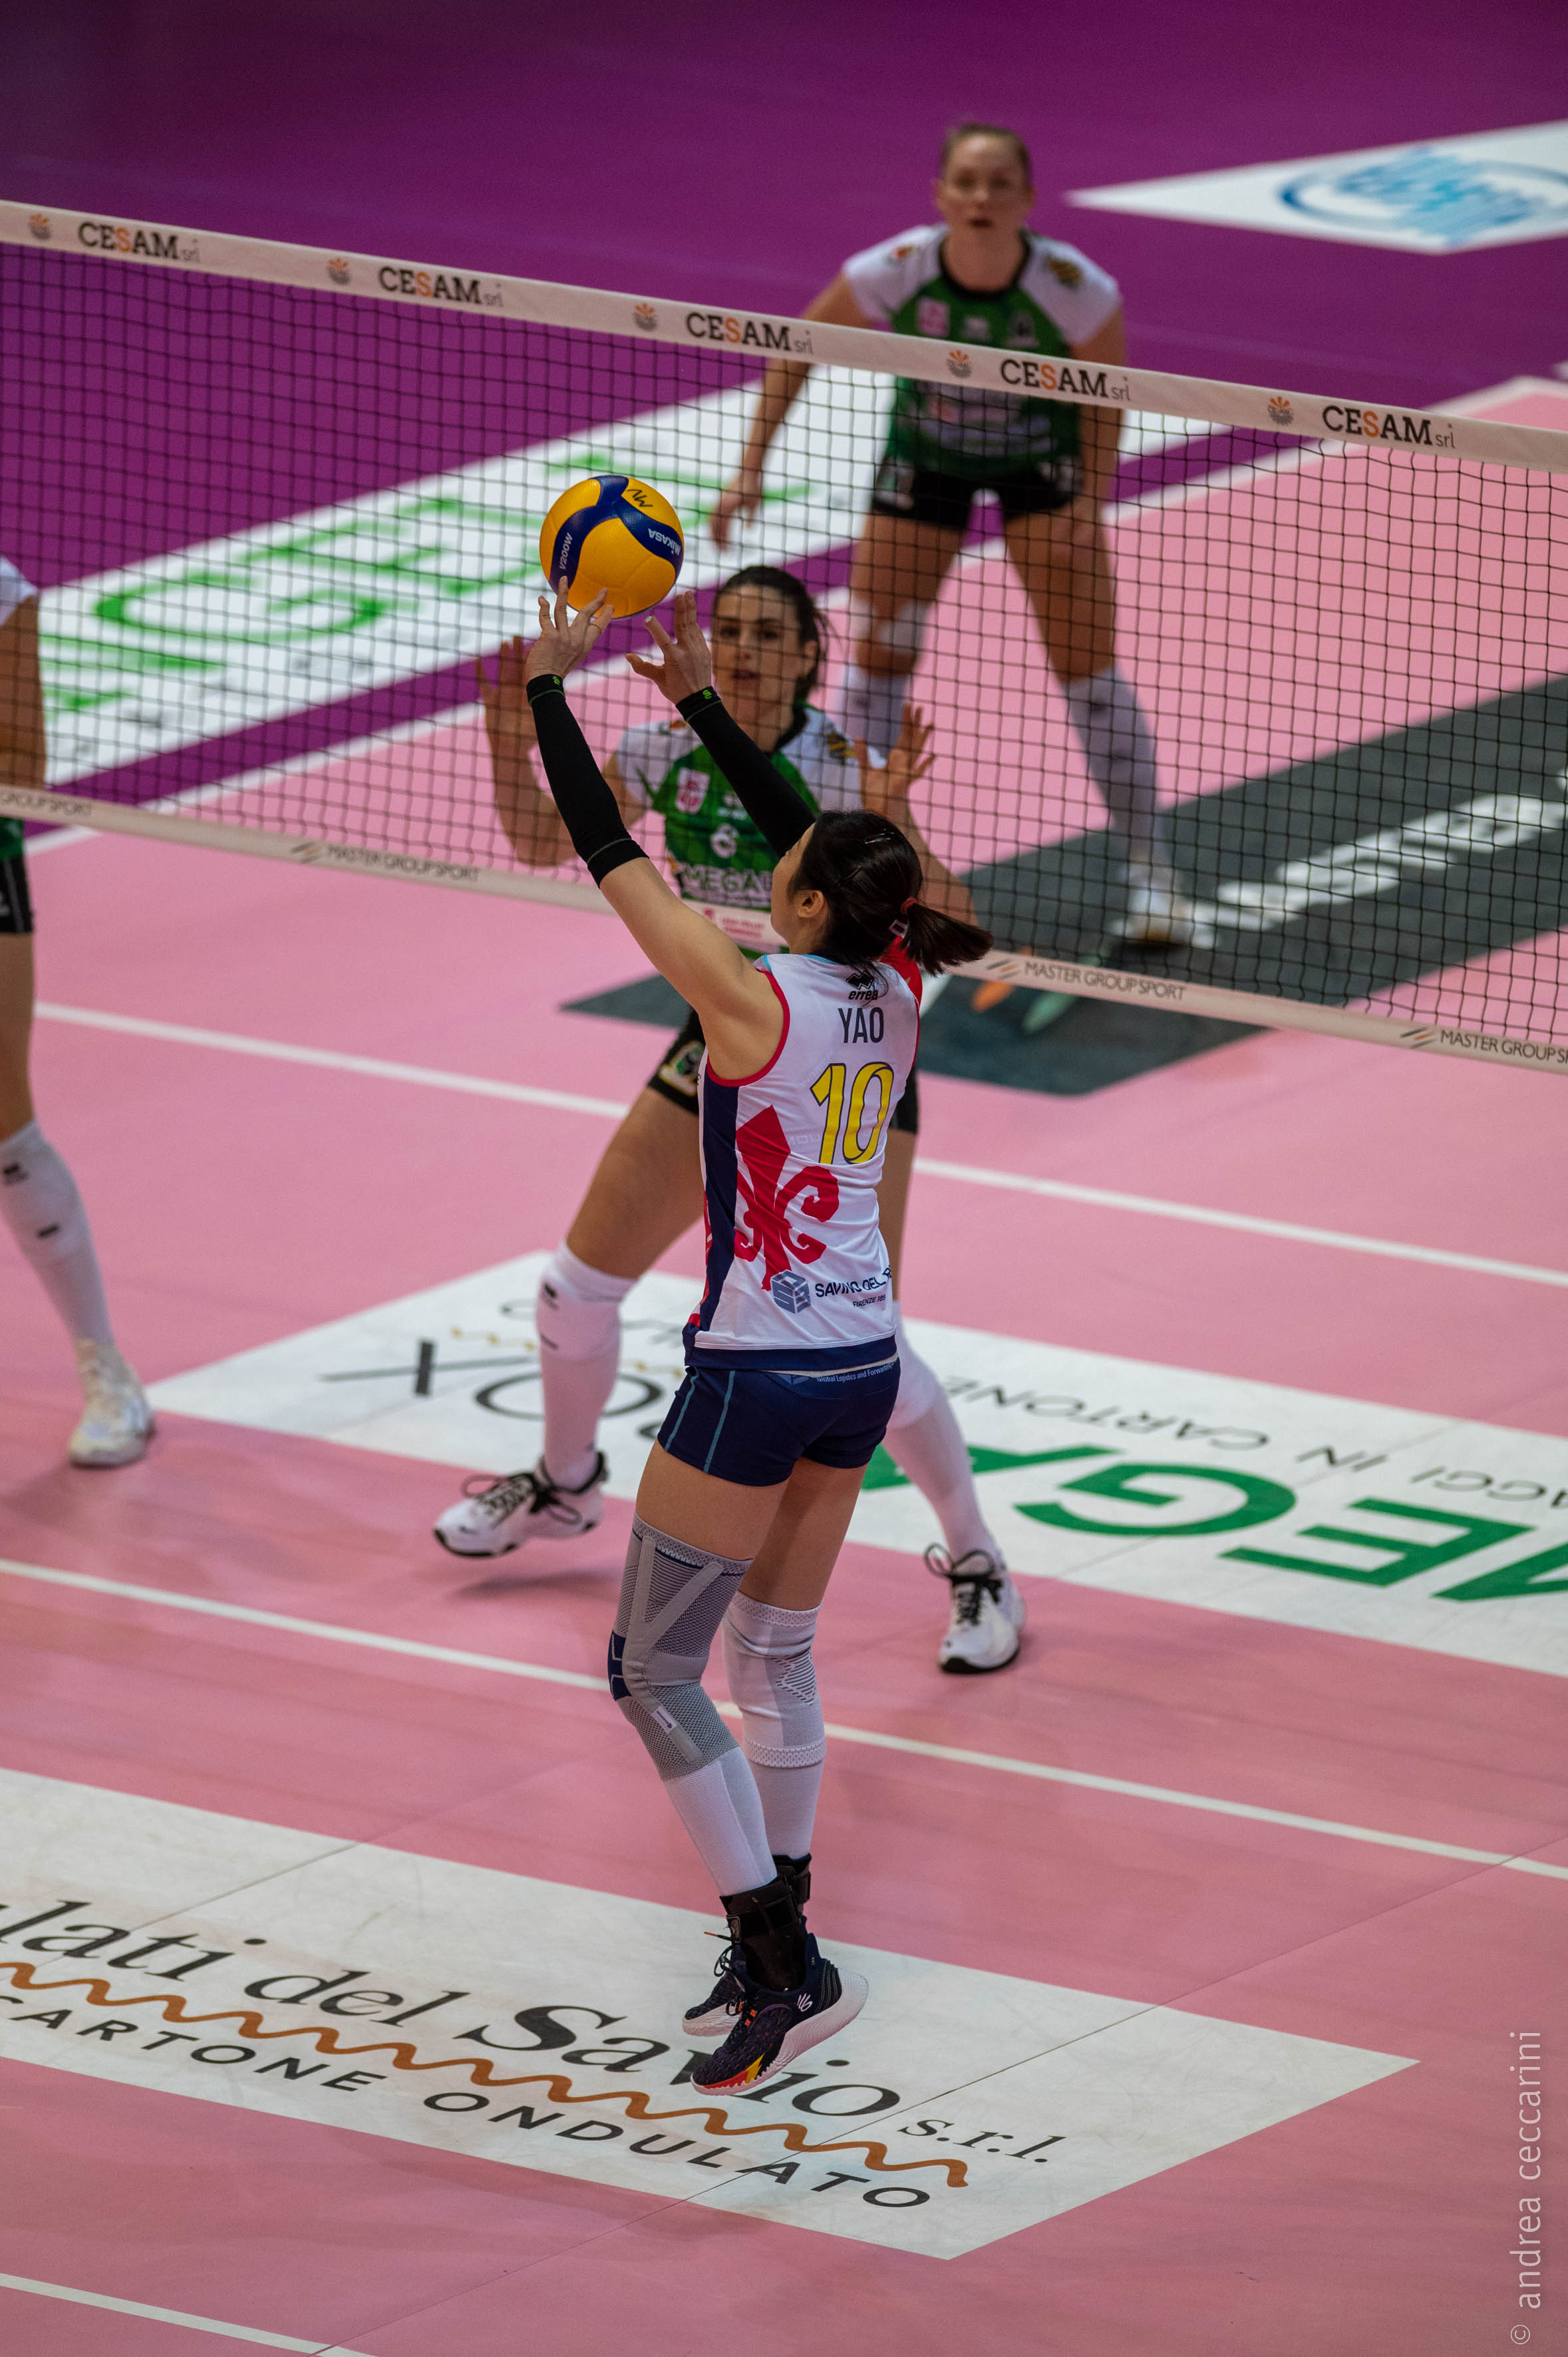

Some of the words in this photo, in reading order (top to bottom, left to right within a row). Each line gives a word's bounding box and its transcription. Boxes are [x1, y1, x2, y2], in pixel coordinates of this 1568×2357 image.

[77, 222, 180, 260] CESAM
[378, 266, 482, 305] CESAM
[686, 311, 792, 352] CESAM
[1000, 359, 1109, 398] CESAM
[1322, 405, 1433, 446] CESAM
[559, 532, 573, 570] V200W
[1024, 962, 1081, 985] MASTER
[1084, 971, 1139, 993] GROUP
[1139, 981, 1187, 1001] SPORT
[838, 1007, 884, 1044] YAO
[1440, 1029, 1498, 1052] MASTER
[1501, 1040, 1556, 1062] GROUP
[810, 1061, 894, 1165] 10
[853, 1297, 877, 1308] FIRENZE
[836, 1373, 856, 1383] Logistics
[857, 1370, 867, 1379] and
[1296, 1444, 1388, 1473] IN
[0, 1899, 267, 1982] lati
[243, 1968, 471, 2028] del
[897, 2119, 1067, 2163] s.r.l.
[0, 1995, 388, 2093] ARTONE
[423, 2092, 931, 2209] ONDULATO
